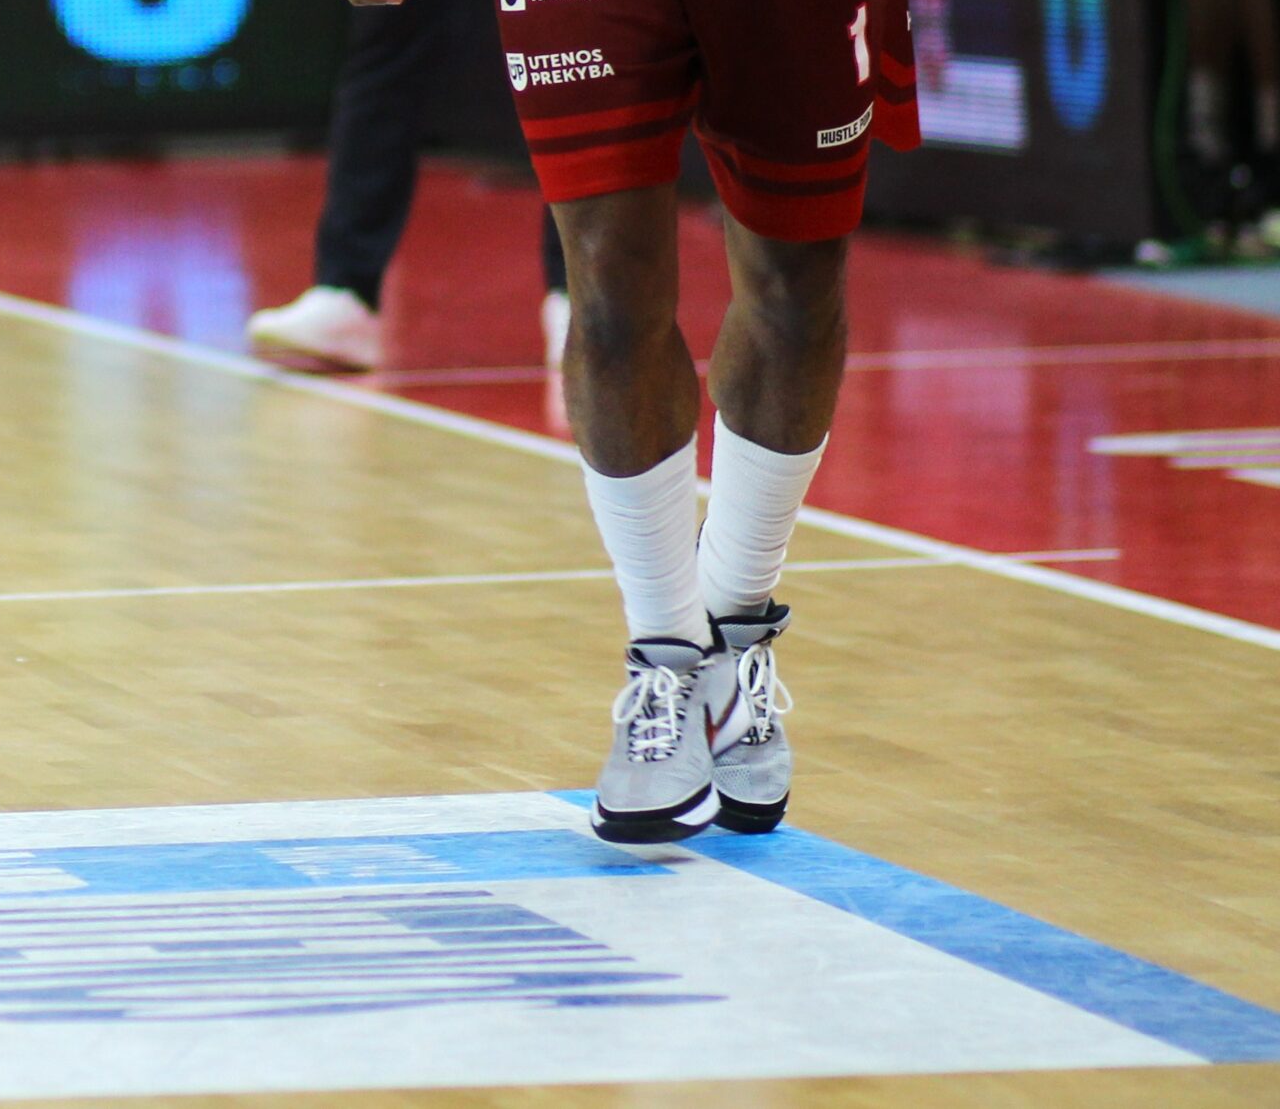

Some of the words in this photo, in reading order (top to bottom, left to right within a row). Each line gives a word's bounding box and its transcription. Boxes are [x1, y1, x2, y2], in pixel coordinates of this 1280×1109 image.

[849, 4, 870, 85] 1
[527, 49, 603, 70] UTENOS
[530, 63, 615, 86] PREKYBA
[821, 123, 858, 145] HUSTLE
